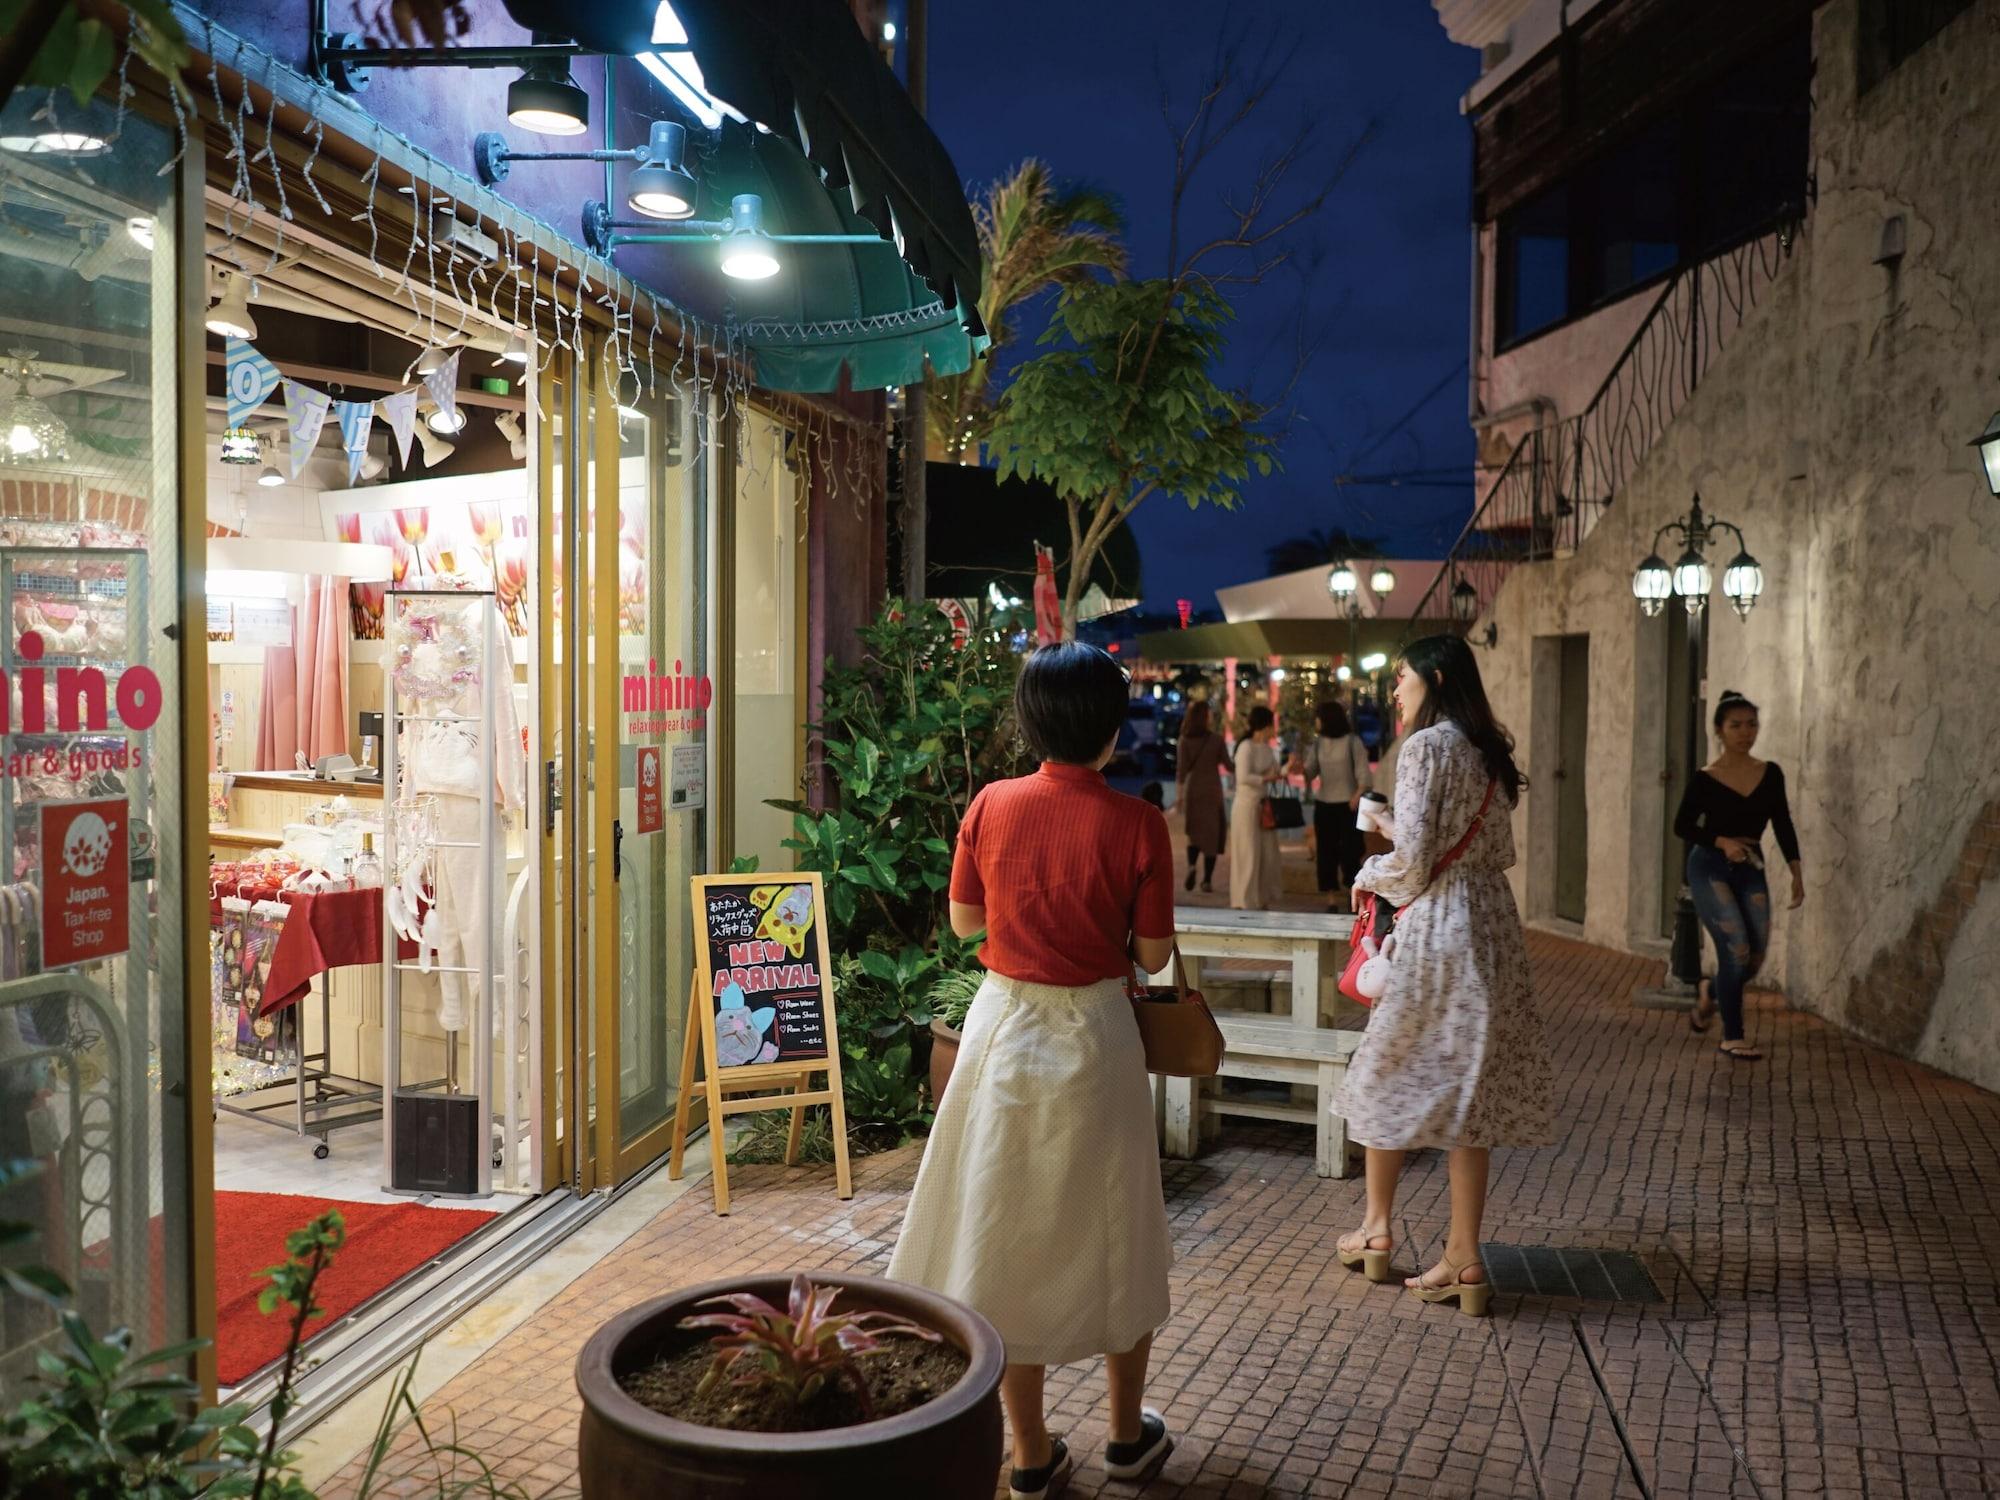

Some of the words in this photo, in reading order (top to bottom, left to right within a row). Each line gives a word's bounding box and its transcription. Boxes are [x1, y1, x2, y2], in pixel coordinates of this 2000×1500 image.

[0, 630, 162, 735] ino
[623, 657, 711, 712] minino
[43, 744, 60, 775] &
[68, 739, 142, 781] goods
[64, 908, 112, 927] Tax-free
[709, 899, 741, 912] あたたか
[72, 930, 104, 946] Shop
[712, 924, 739, 937] 入荷中
[729, 940, 786, 966] NEW
[713, 963, 819, 996] ARRIVAL
